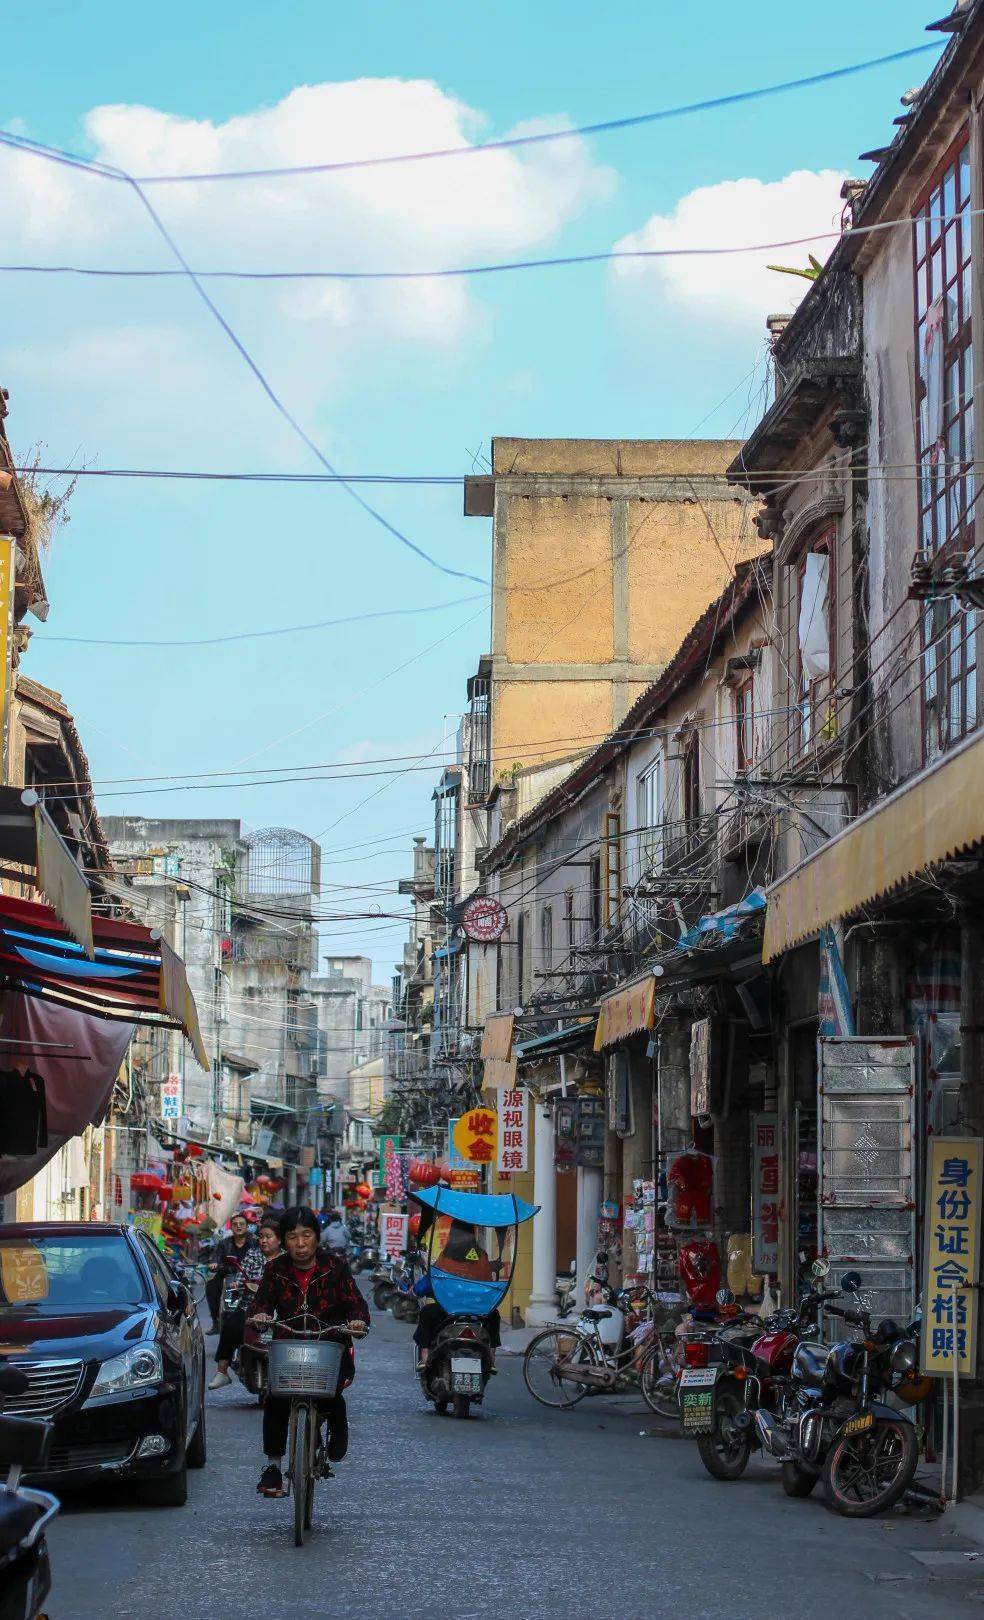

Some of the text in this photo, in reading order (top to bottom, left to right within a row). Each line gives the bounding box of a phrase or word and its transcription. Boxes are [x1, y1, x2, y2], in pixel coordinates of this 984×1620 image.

[467, 1112, 495, 1161] 收金
[932, 1157, 974, 1359] 身份证合格照
